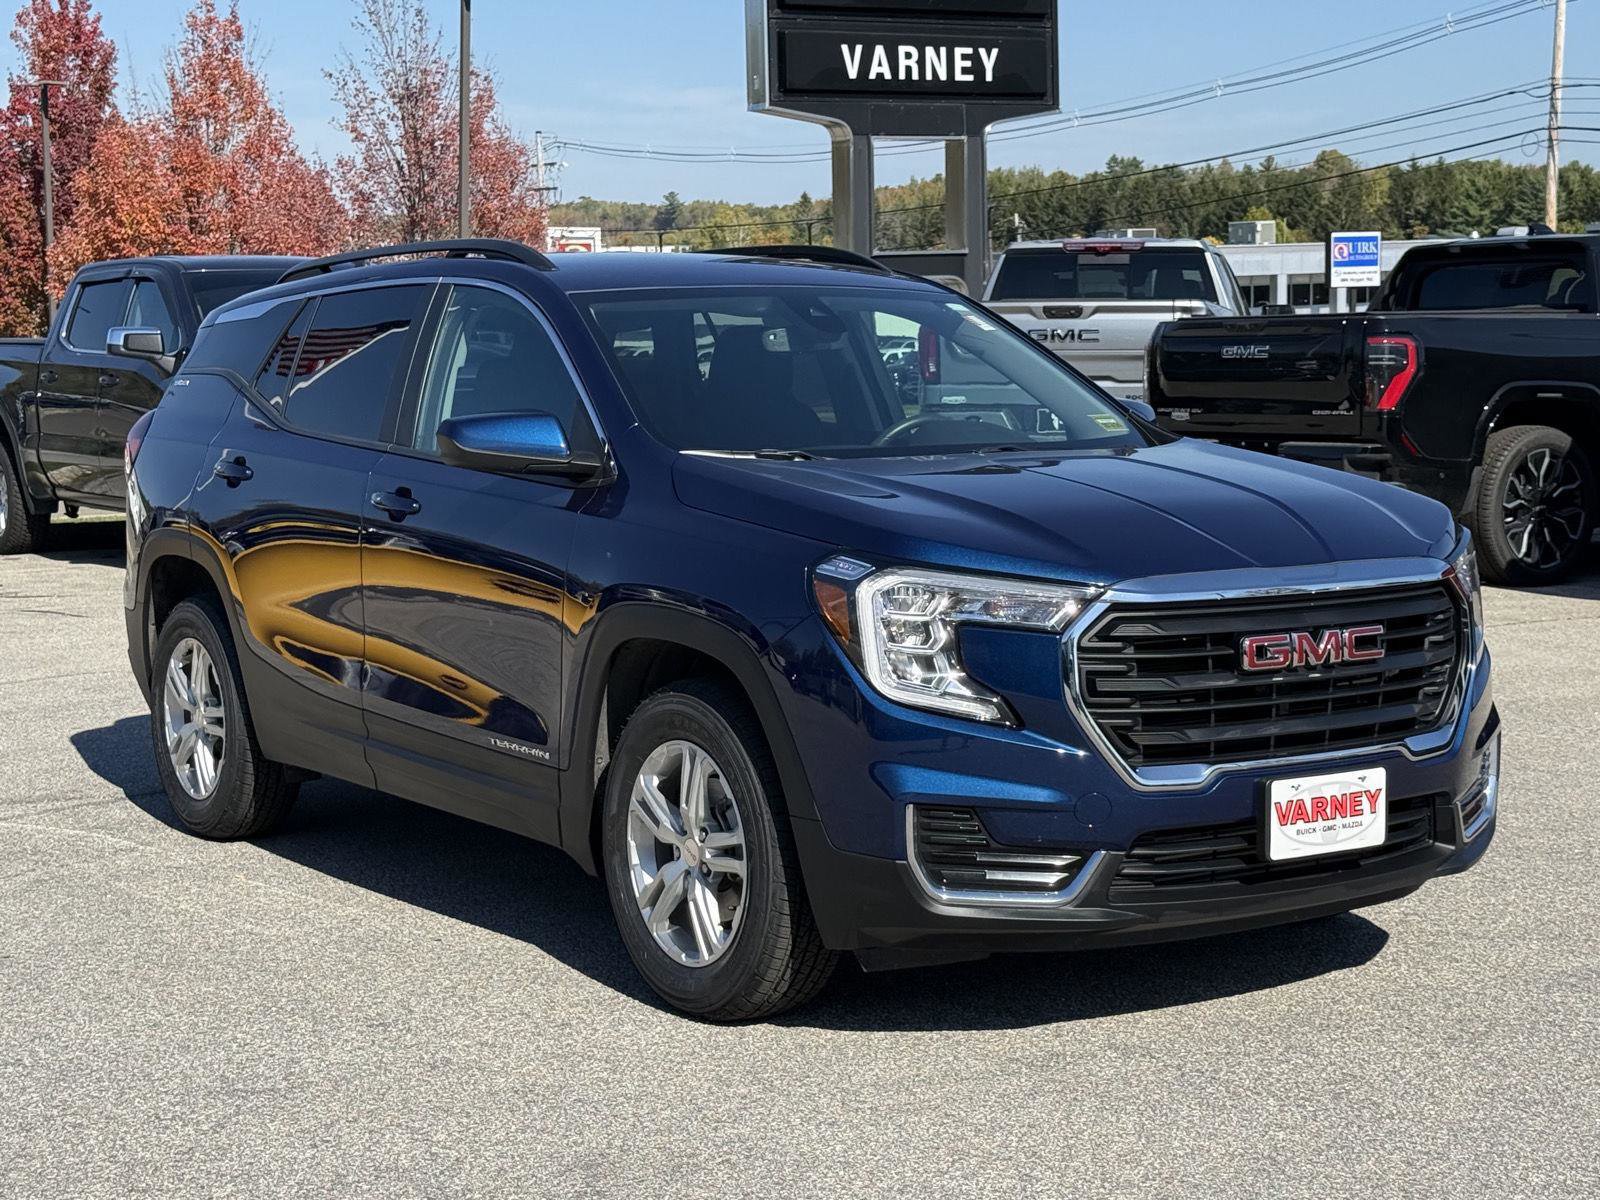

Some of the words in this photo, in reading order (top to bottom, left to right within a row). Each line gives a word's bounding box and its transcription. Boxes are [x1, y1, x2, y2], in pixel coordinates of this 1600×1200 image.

[840, 43, 999, 82] VARNEY
[1028, 328, 1100, 343] GMC
[1221, 345, 1270, 359] GMC
[1240, 625, 1385, 671] GMC
[488, 736, 551, 760] TERRAIN
[1274, 788, 1383, 827] VARNEY
[1296, 826, 1317, 836] BUICK
[1322, 824, 1337, 833] GMC
[1341, 820, 1364, 830] MAZDA
